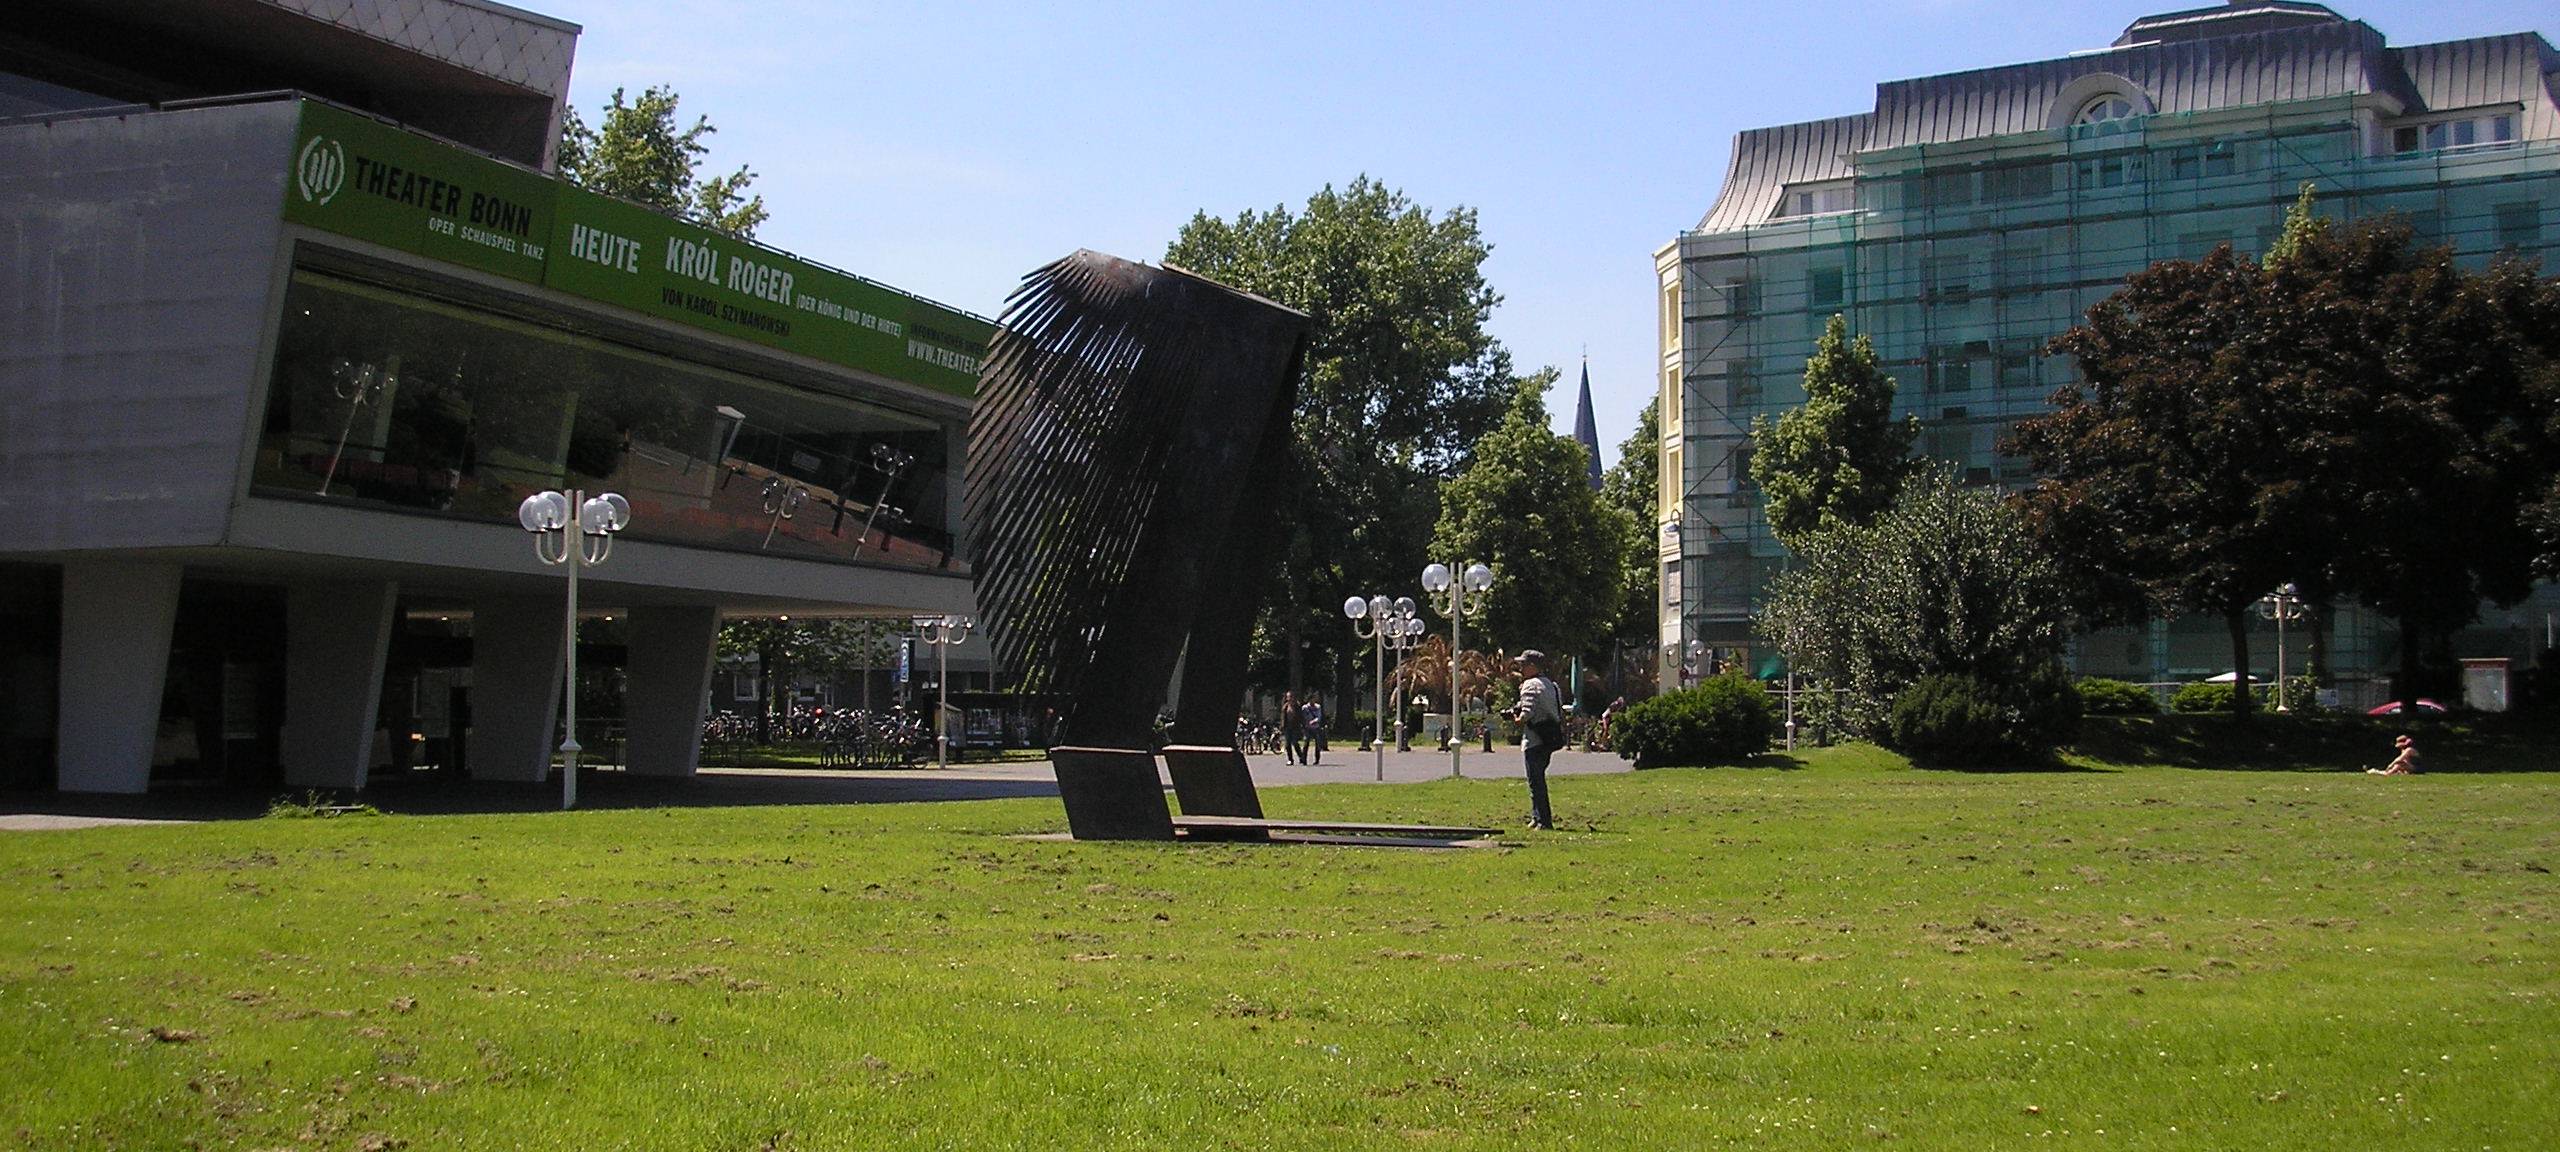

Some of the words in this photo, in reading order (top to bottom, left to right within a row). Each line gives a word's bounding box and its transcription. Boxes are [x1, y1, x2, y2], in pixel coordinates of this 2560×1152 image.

[355, 157, 460, 216] THEATER
[469, 192, 532, 237] BONN
[429, 216, 455, 236] OPER
[461, 226, 516, 253] SCHAUSPIEL
[522, 242, 545, 261] TANZ
[570, 223, 641, 274] HEUTE
[665, 236, 720, 285] KRÓL
[727, 256, 794, 306] ROGER
[663, 287, 684, 308] VON
[722, 306, 791, 336] SZYMANOWSKI
[843, 307, 860, 325] UND
[861, 312, 877, 329] DER
